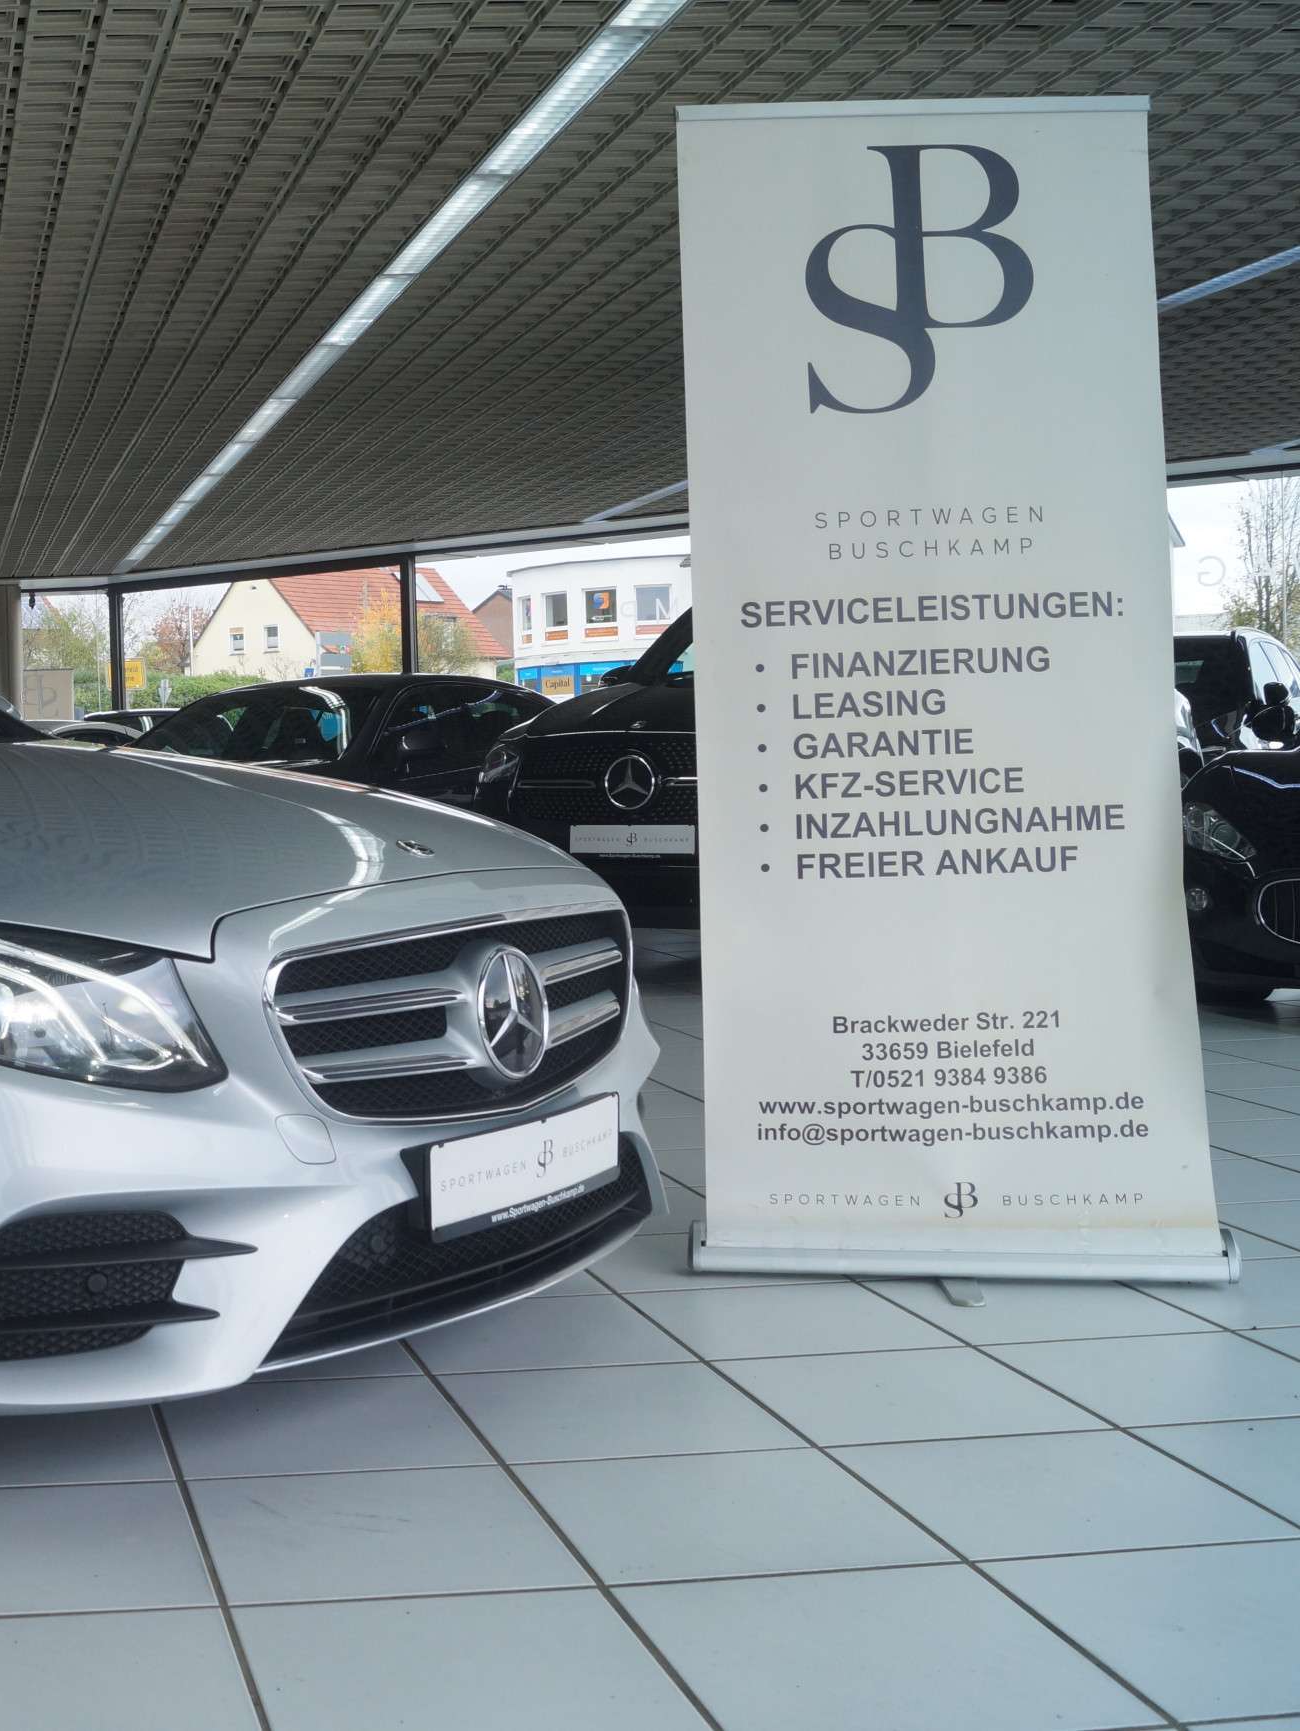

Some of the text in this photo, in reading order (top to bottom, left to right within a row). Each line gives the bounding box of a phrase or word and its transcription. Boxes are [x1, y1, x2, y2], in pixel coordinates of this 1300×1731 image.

[814, 505, 1045, 530] SPORTWAGEN
[828, 536, 1033, 561] BUSCHKAMP
[740, 590, 1125, 628] SERVICELEISTUNGEN:
[790, 646, 1051, 680] FINANZIERUNG
[545, 677, 570, 690] Capital
[792, 688, 947, 720] LEASING
[792, 728, 975, 760] GARANTIE
[794, 766, 1025, 800] KFZ-SERVICE
[795, 804, 1126, 840] INZAHLUNGNAHME
[796, 845, 1079, 880] FREIER ANKAUF
[832, 1010, 1061, 1034] Brackweder Str. 221
[861, 1039, 1035, 1062] 33659 Bielefeld
[850, 1066, 1048, 1090] T/0521 9384 9386
[758, 1092, 1145, 1120] www.sportwagen-buschkamp.de
[757, 1120, 1149, 1147] info@sportwagen-buschkamp.de
[439, 1159, 527, 1193] SPORTWAGEN
[769, 1193, 922, 1208] SPORTWAGEN
[1002, 1192, 1145, 1207] BUSCHKAMP
